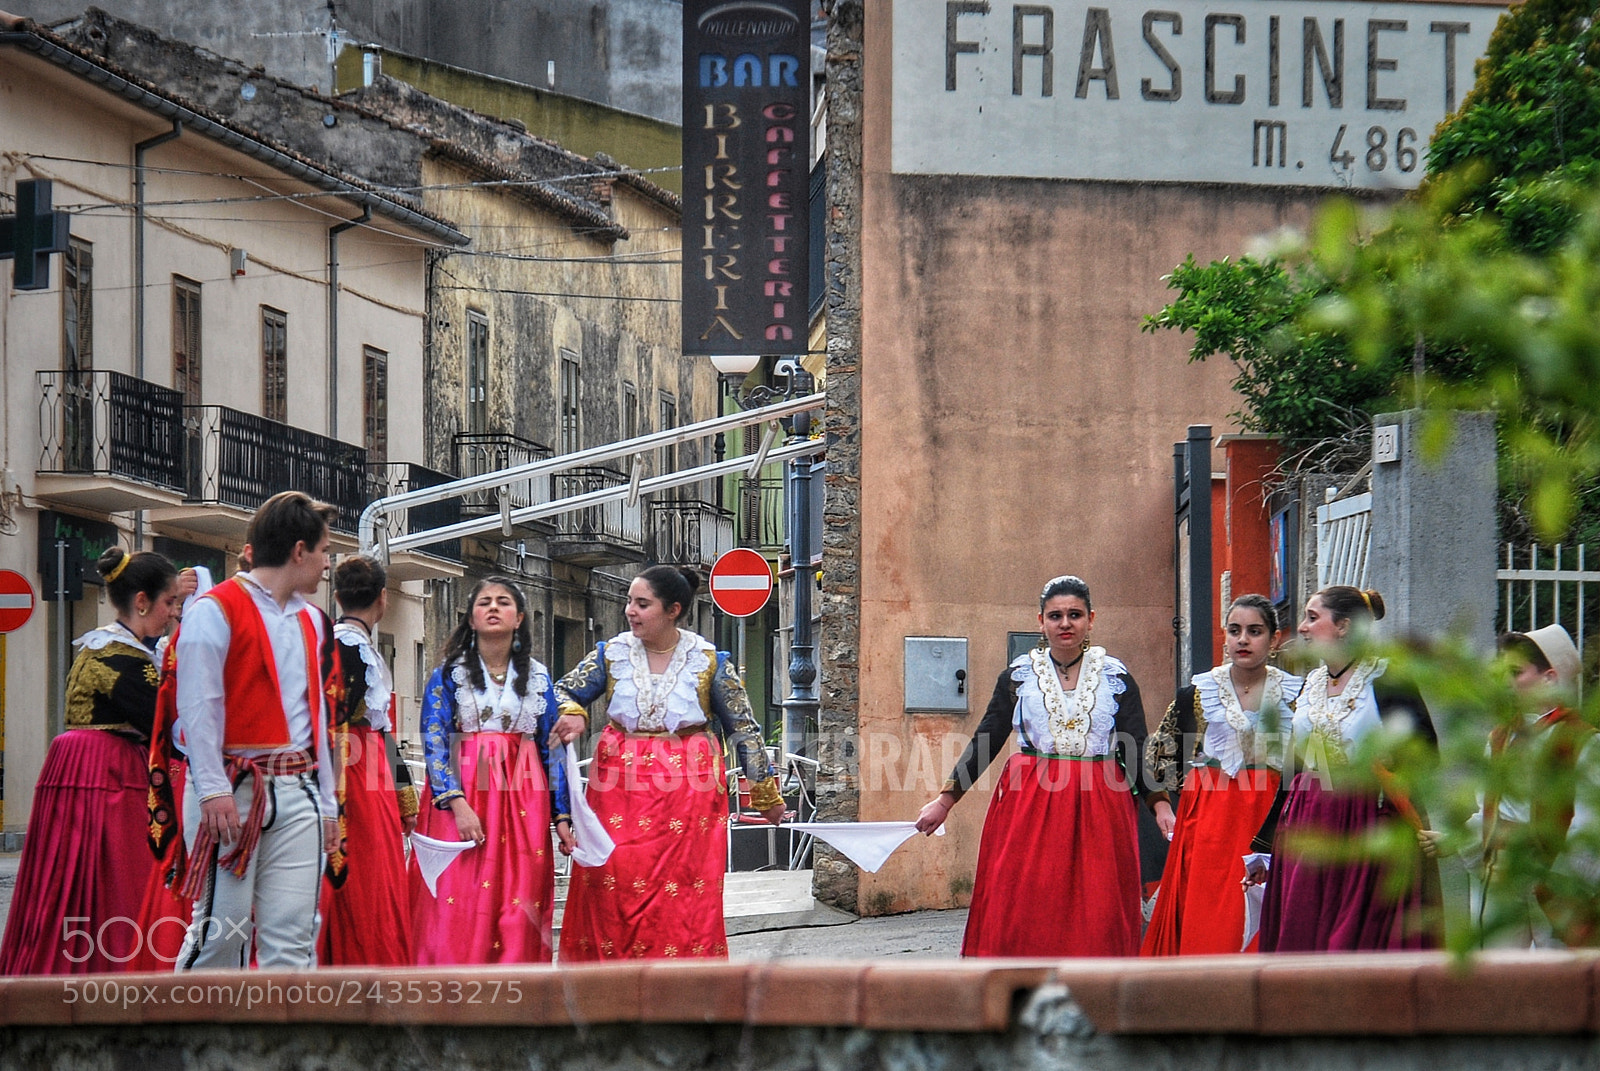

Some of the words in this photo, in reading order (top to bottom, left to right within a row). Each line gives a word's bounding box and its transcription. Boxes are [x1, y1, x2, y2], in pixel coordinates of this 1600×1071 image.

[705, 19, 797, 36] MILLENNIUM
[698, 53, 799, 88] BAR
[1329, 123, 1419, 173] 486
[700, 103, 744, 341] BIRRERIA
[762, 103, 797, 341] CAFFETTERIA
